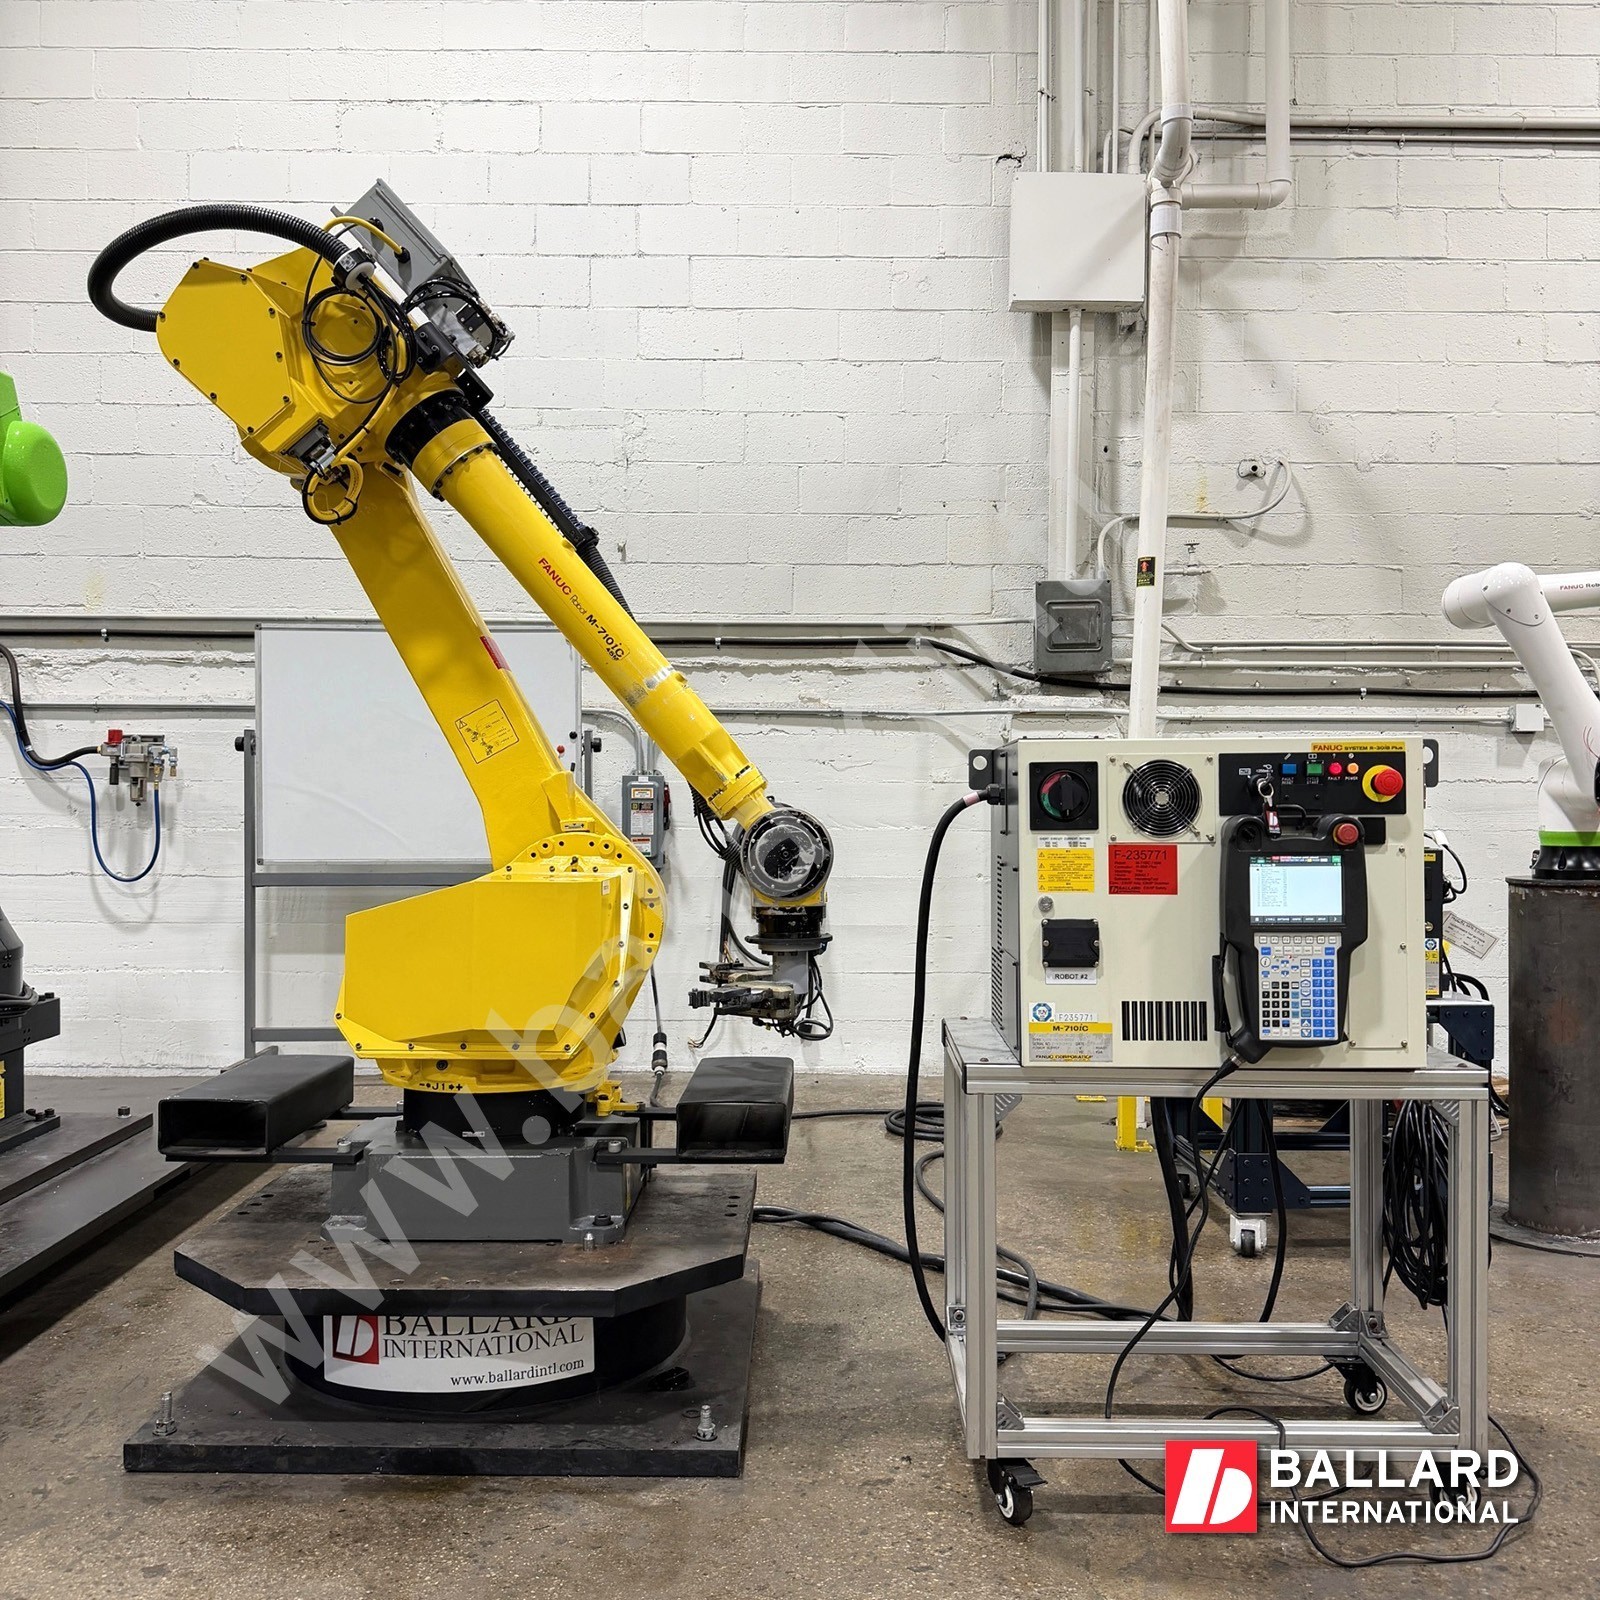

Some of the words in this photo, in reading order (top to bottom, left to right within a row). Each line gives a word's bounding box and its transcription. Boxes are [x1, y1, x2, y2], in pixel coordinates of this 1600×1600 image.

[538, 557, 572, 595] FANUC
[569, 594, 587, 615] Robot
[585, 614, 625, 658] M-710iC
[1114, 849, 1167, 860] F-235771
[1052, 1023, 1089, 1032] M-710iC
[1058, 1013, 1093, 1021] F235771
[384, 1315, 573, 1337] BALLA
[382, 1323, 585, 1359] INTERNATIONAL
[450, 1358, 585, 1386] www.ballardintl.com
